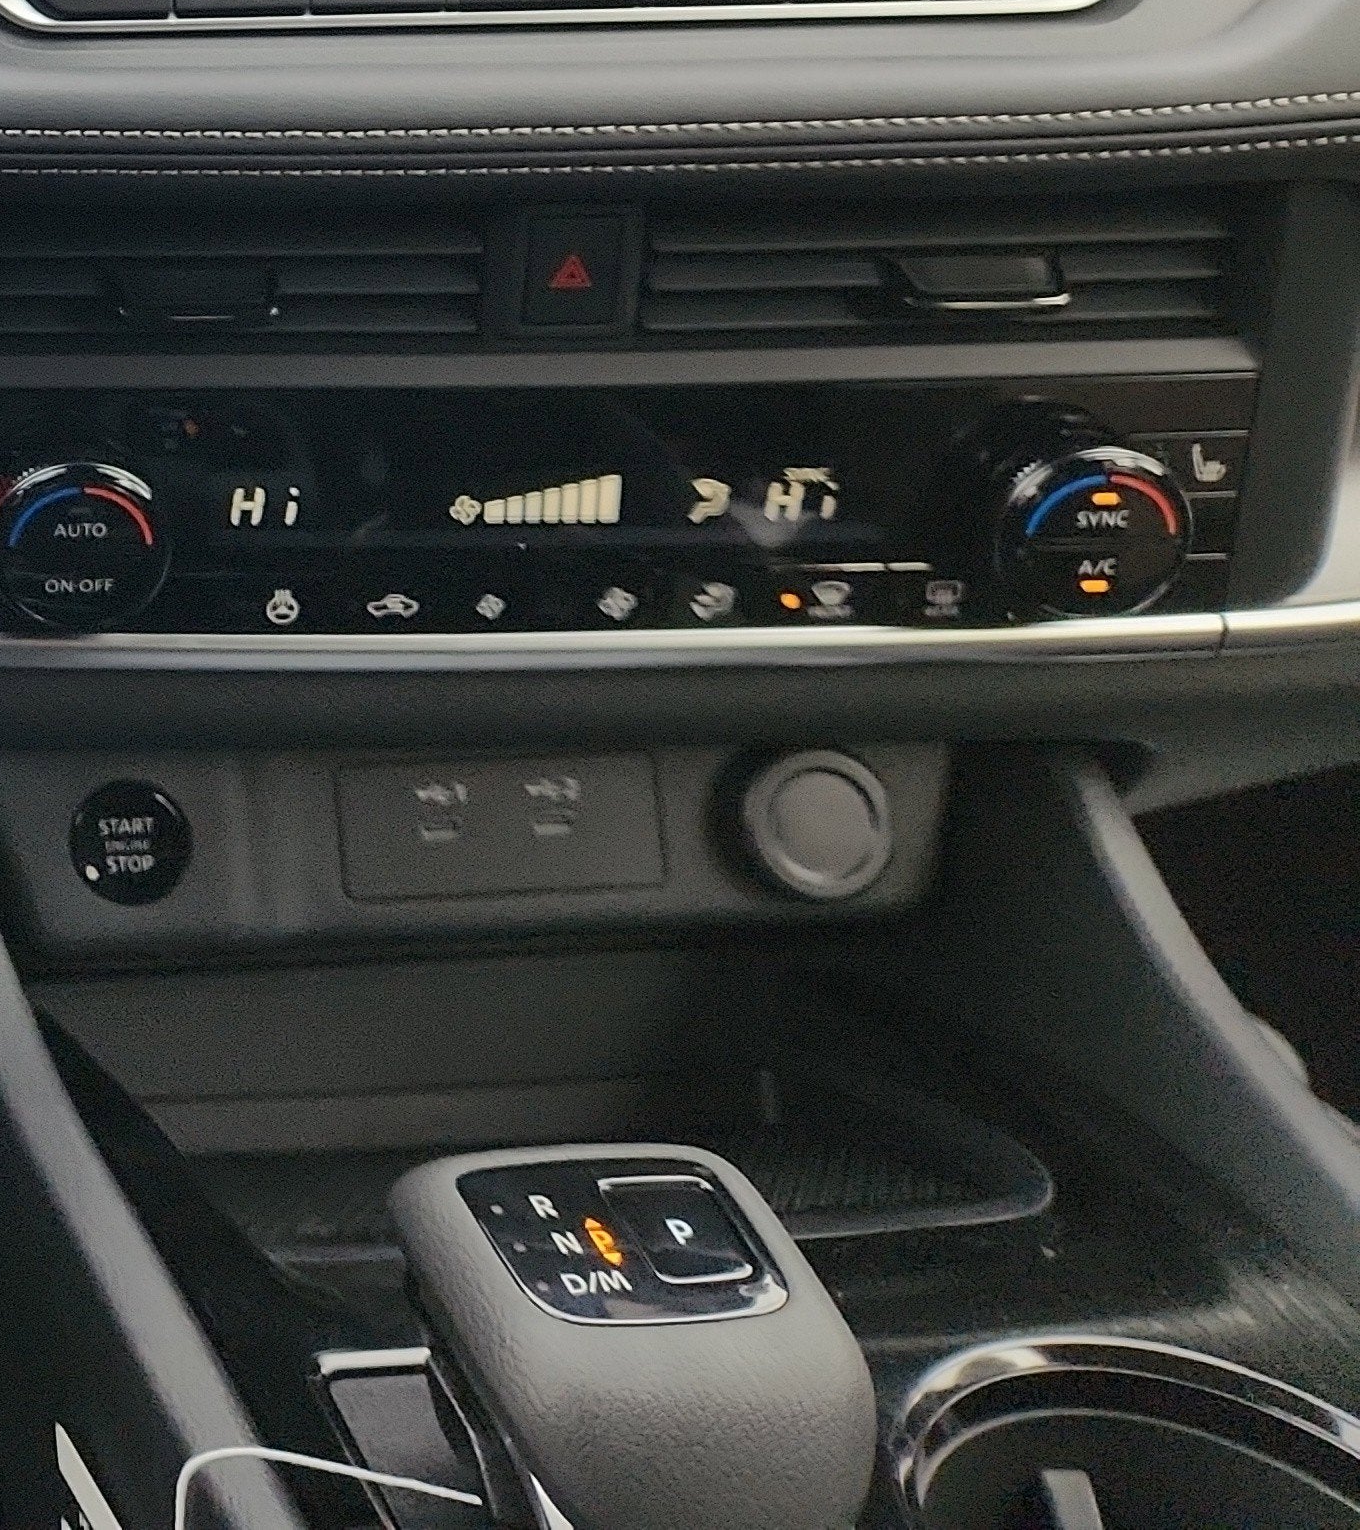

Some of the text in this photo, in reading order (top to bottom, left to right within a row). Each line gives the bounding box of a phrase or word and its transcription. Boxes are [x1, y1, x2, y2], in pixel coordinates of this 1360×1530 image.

[1076, 510, 1131, 529] SYNC
[54, 522, 108, 540] AUTO
[1078, 558, 1117, 576] A/C
[98, 817, 155, 836] START
[105, 854, 156, 875] STOP
[528, 1193, 559, 1220] R
[664, 1217, 695, 1246] P
[550, 1230, 585, 1257] N
[559, 1268, 634, 1298] D/M
